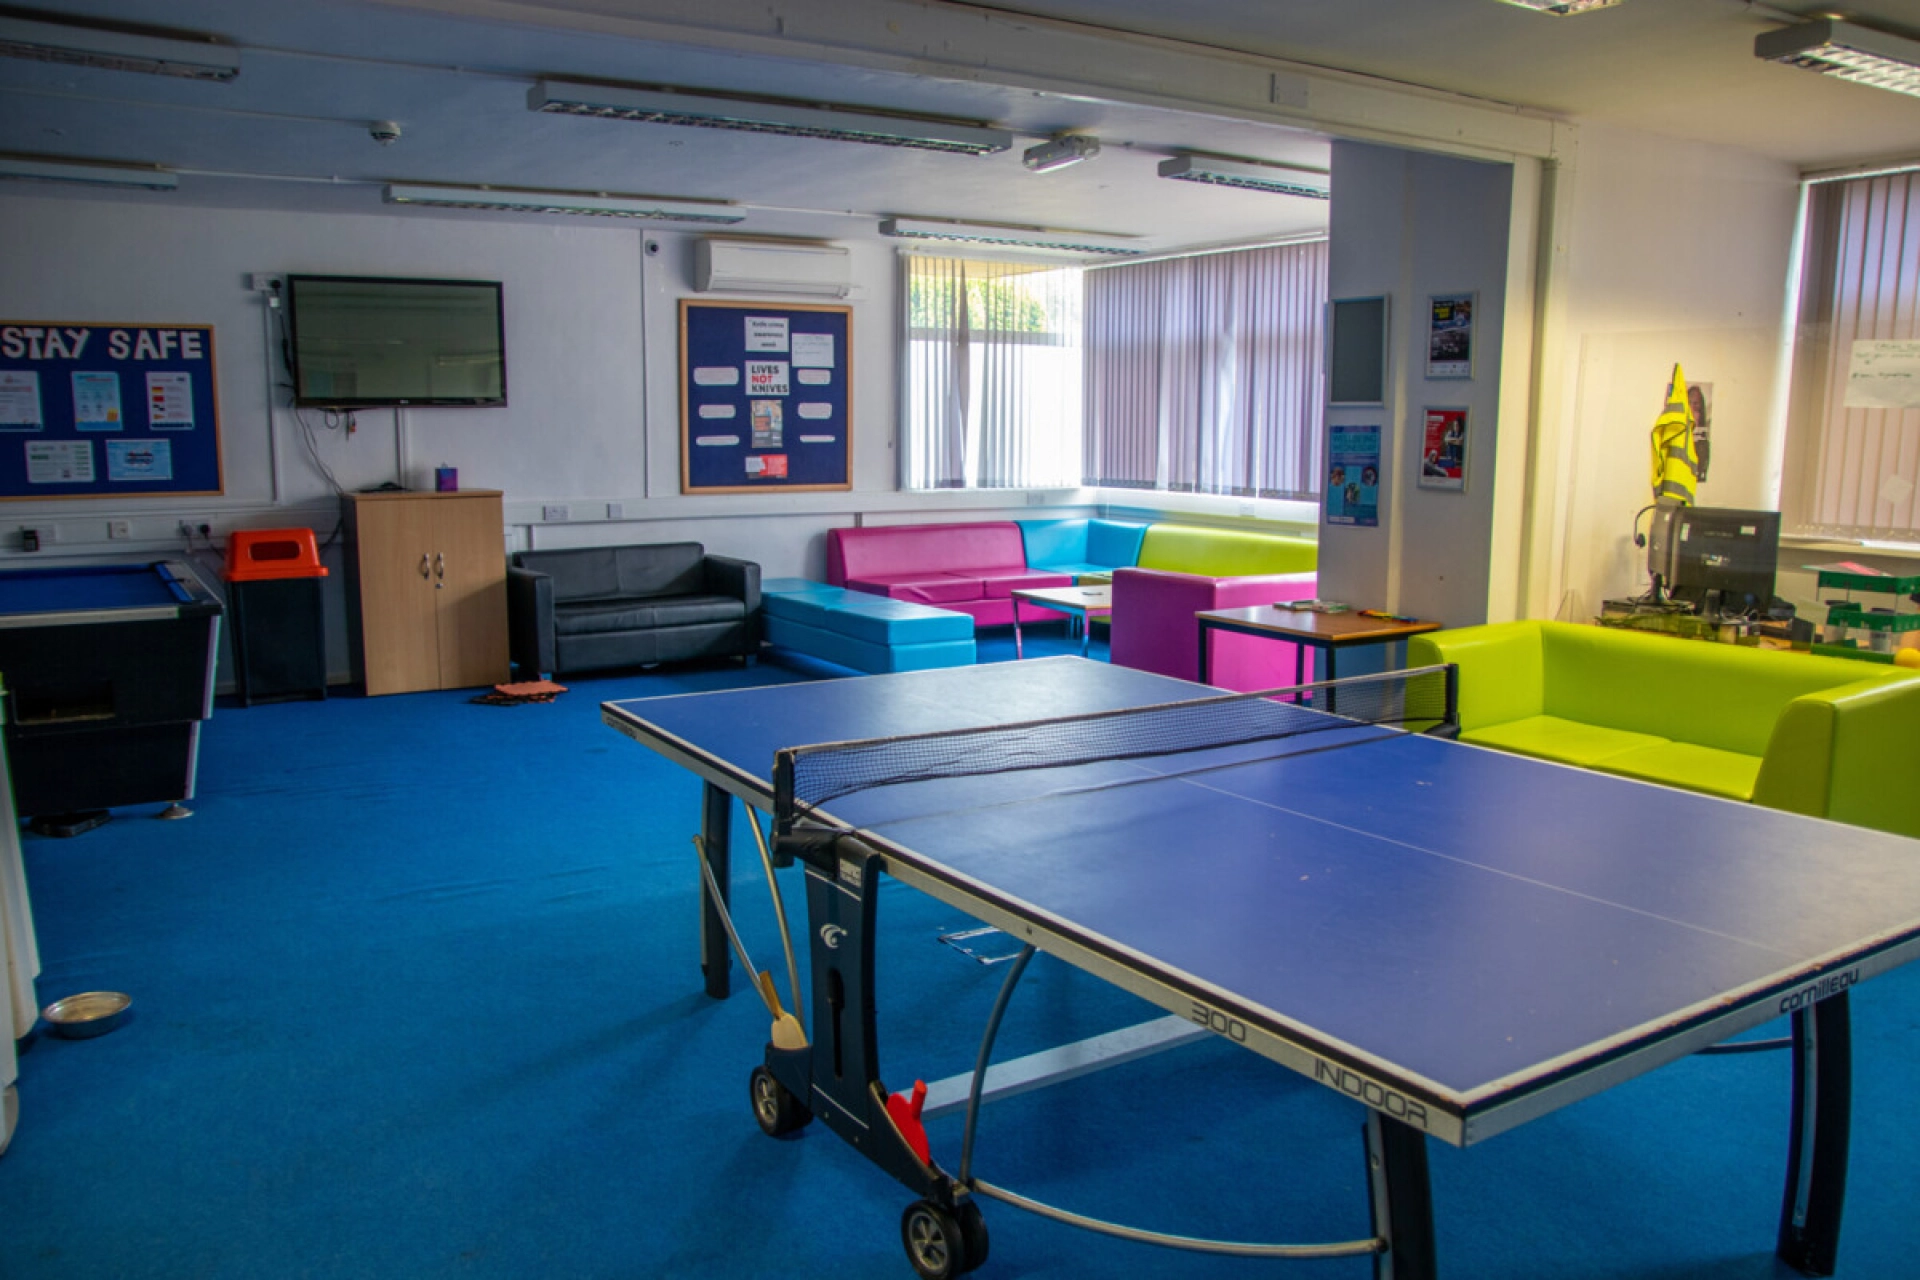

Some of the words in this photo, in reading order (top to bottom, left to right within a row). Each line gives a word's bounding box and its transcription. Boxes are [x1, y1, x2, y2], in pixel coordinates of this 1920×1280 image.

[2, 327, 90, 359] STAY
[108, 329, 203, 359] SAFE
[751, 364, 780, 374] LIVES
[751, 375, 774, 383] NOT
[751, 384, 788, 393] KNIVES
[1780, 968, 1859, 1013] cornilleau
[1192, 1002, 1246, 1043] 300
[1314, 1058, 1428, 1129] INDOOR
